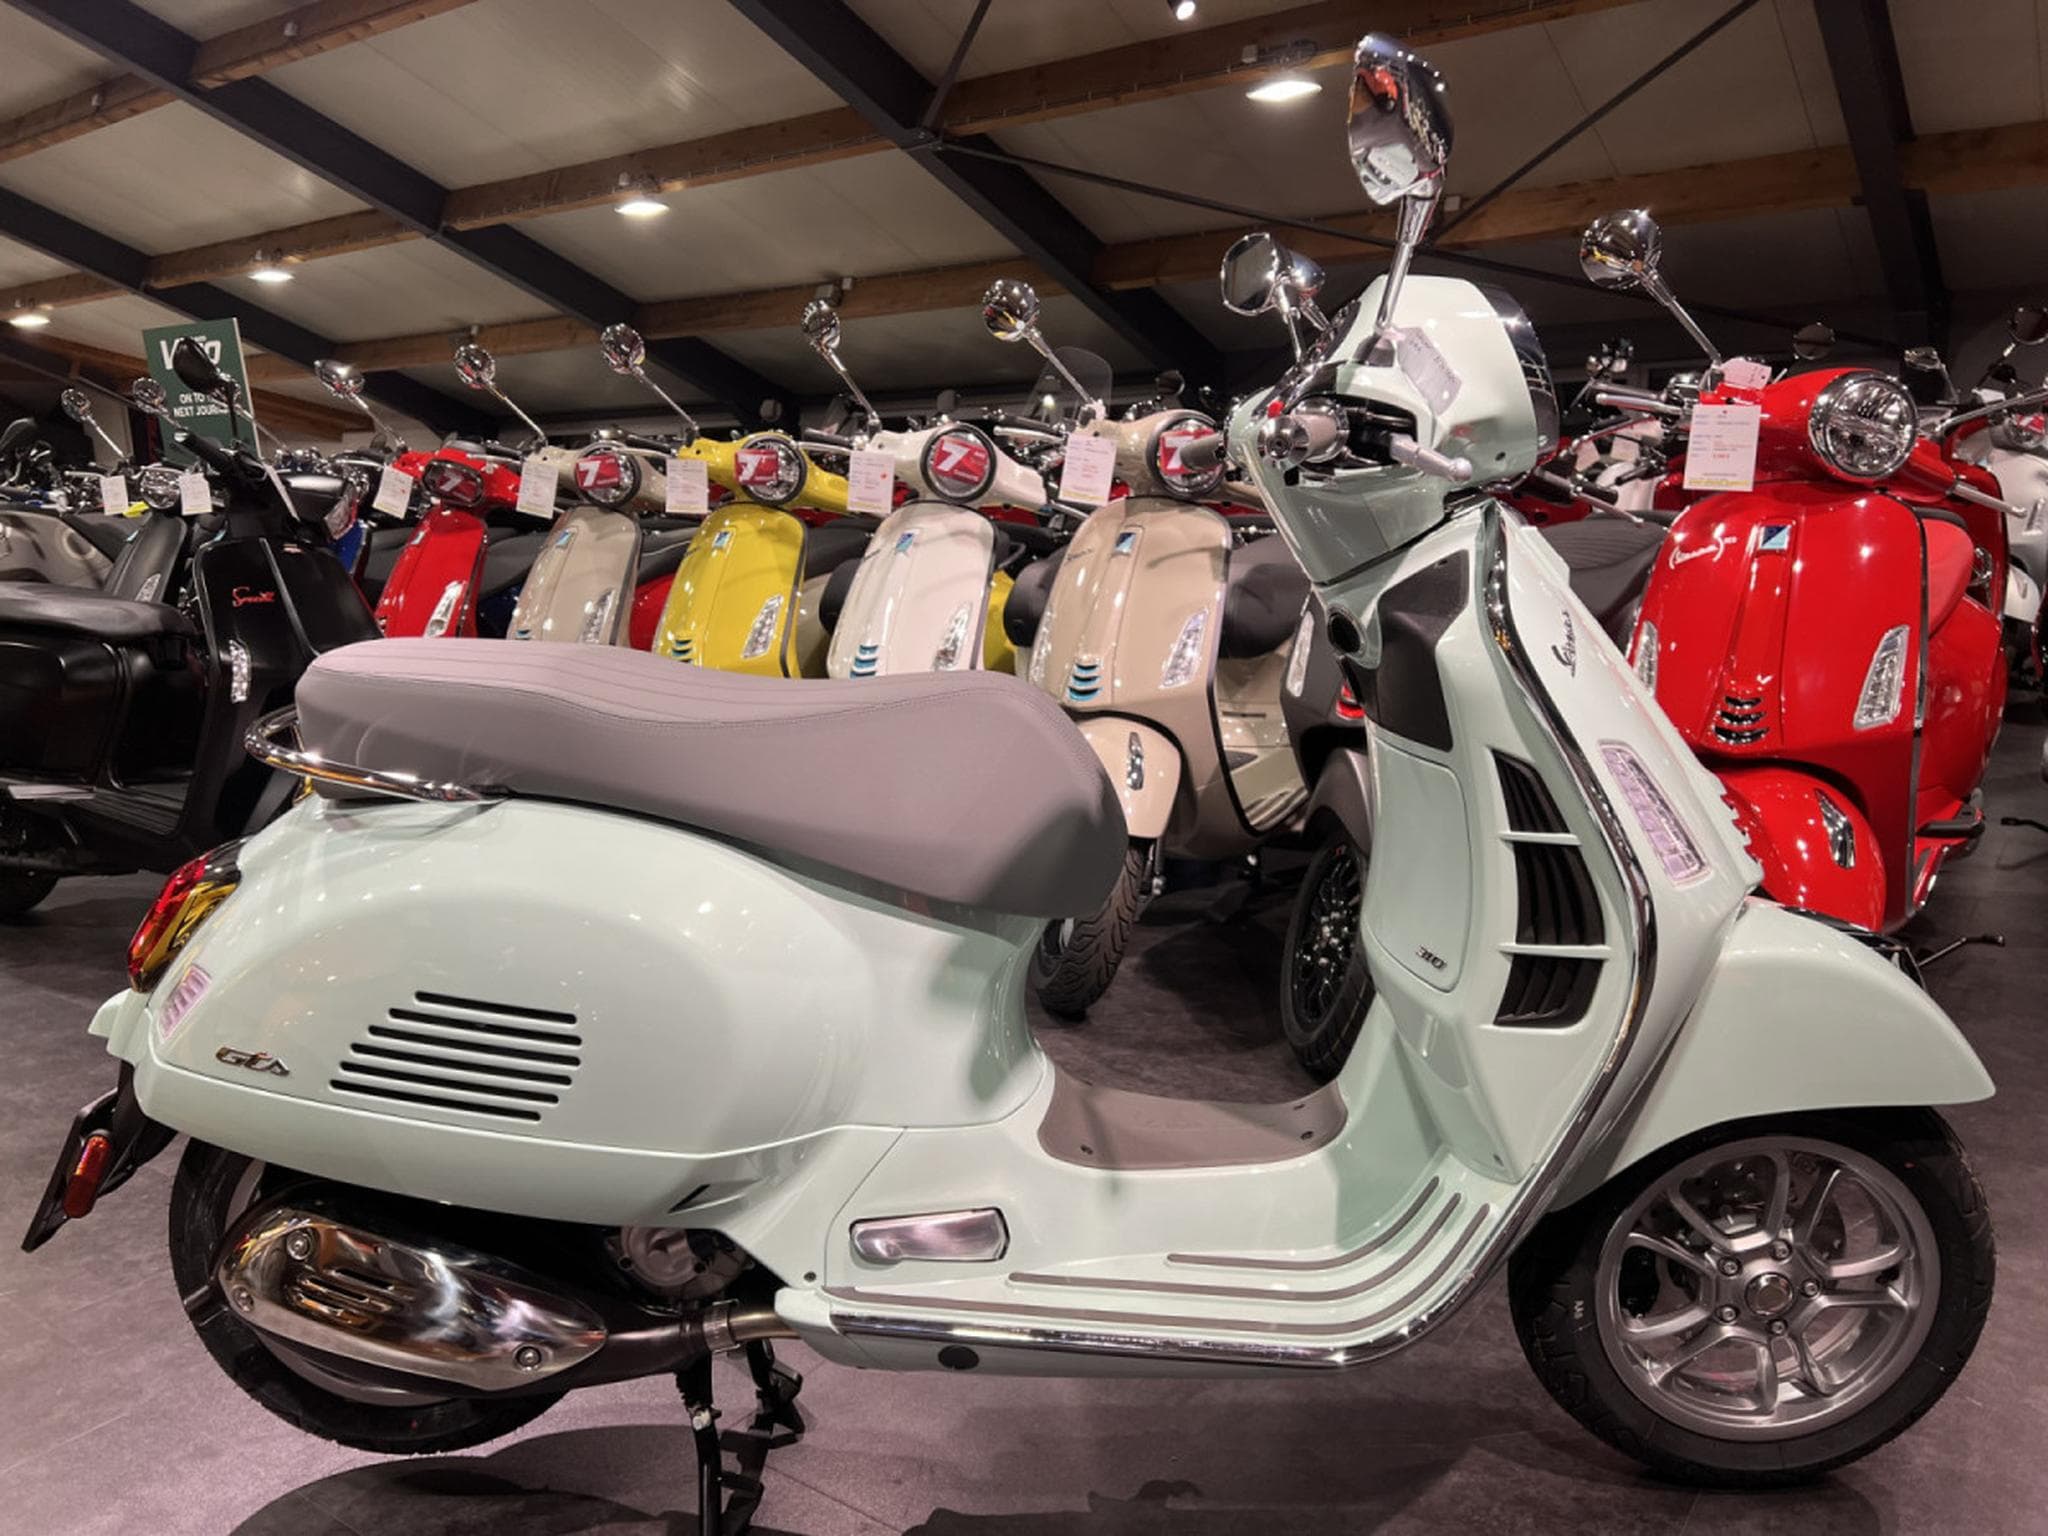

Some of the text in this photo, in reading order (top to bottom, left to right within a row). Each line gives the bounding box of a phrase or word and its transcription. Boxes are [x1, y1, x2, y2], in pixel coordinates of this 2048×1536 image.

[173, 405, 194, 418] NEXT
[179, 393, 193, 405] ON
[193, 392, 205, 403] TO
[735, 452, 762, 483] 7
[936, 440, 971, 473] 7
[579, 460, 602, 487] 7
